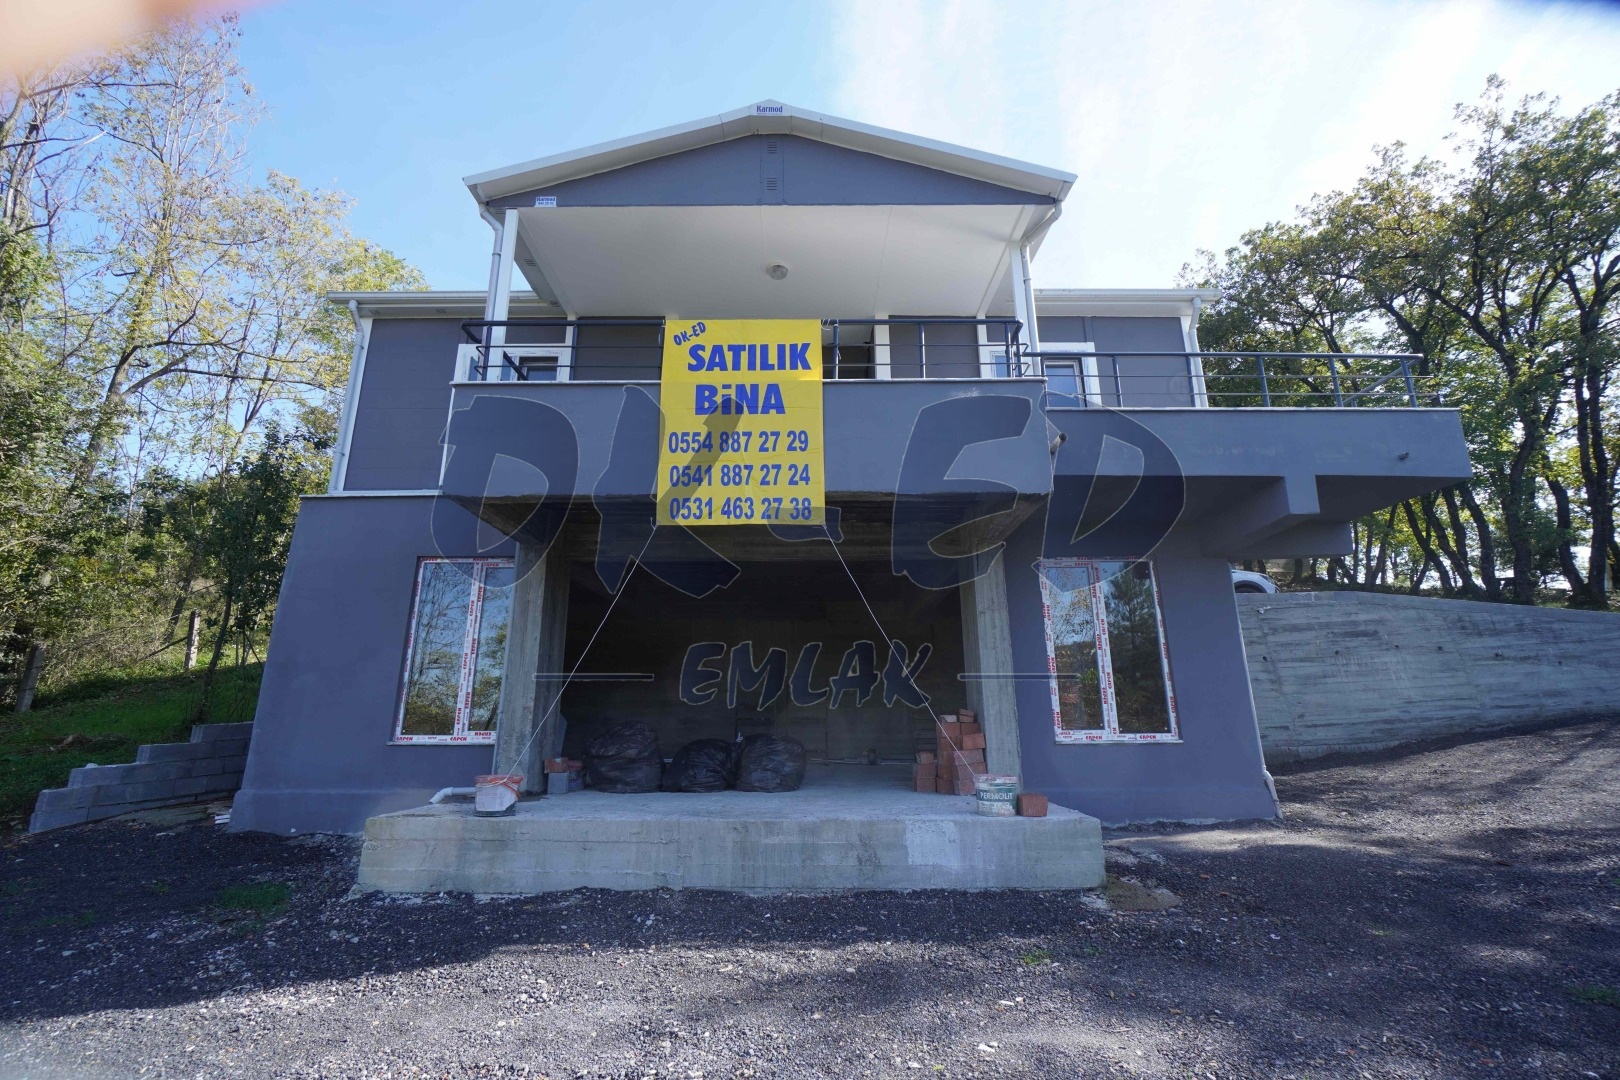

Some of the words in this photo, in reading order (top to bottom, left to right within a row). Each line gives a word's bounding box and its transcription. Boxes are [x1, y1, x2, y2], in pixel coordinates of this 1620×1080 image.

[756, 105, 783, 113] Karmod
[687, 342, 812, 372] SATILIK
[668, 431, 713, 454] 0554
[719, 431, 753, 453] 887
[758, 430, 781, 453] 27
[786, 430, 809, 452] 29
[669, 465, 713, 488] 0541
[720, 464, 754, 487] 887
[759, 463, 782, 486] 27
[788, 463, 811, 486] 24
[669, 496, 713, 520] 0531
[720, 496, 754, 520] 463
[760, 497, 782, 520] 27
[789, 497, 812, 521] 38
